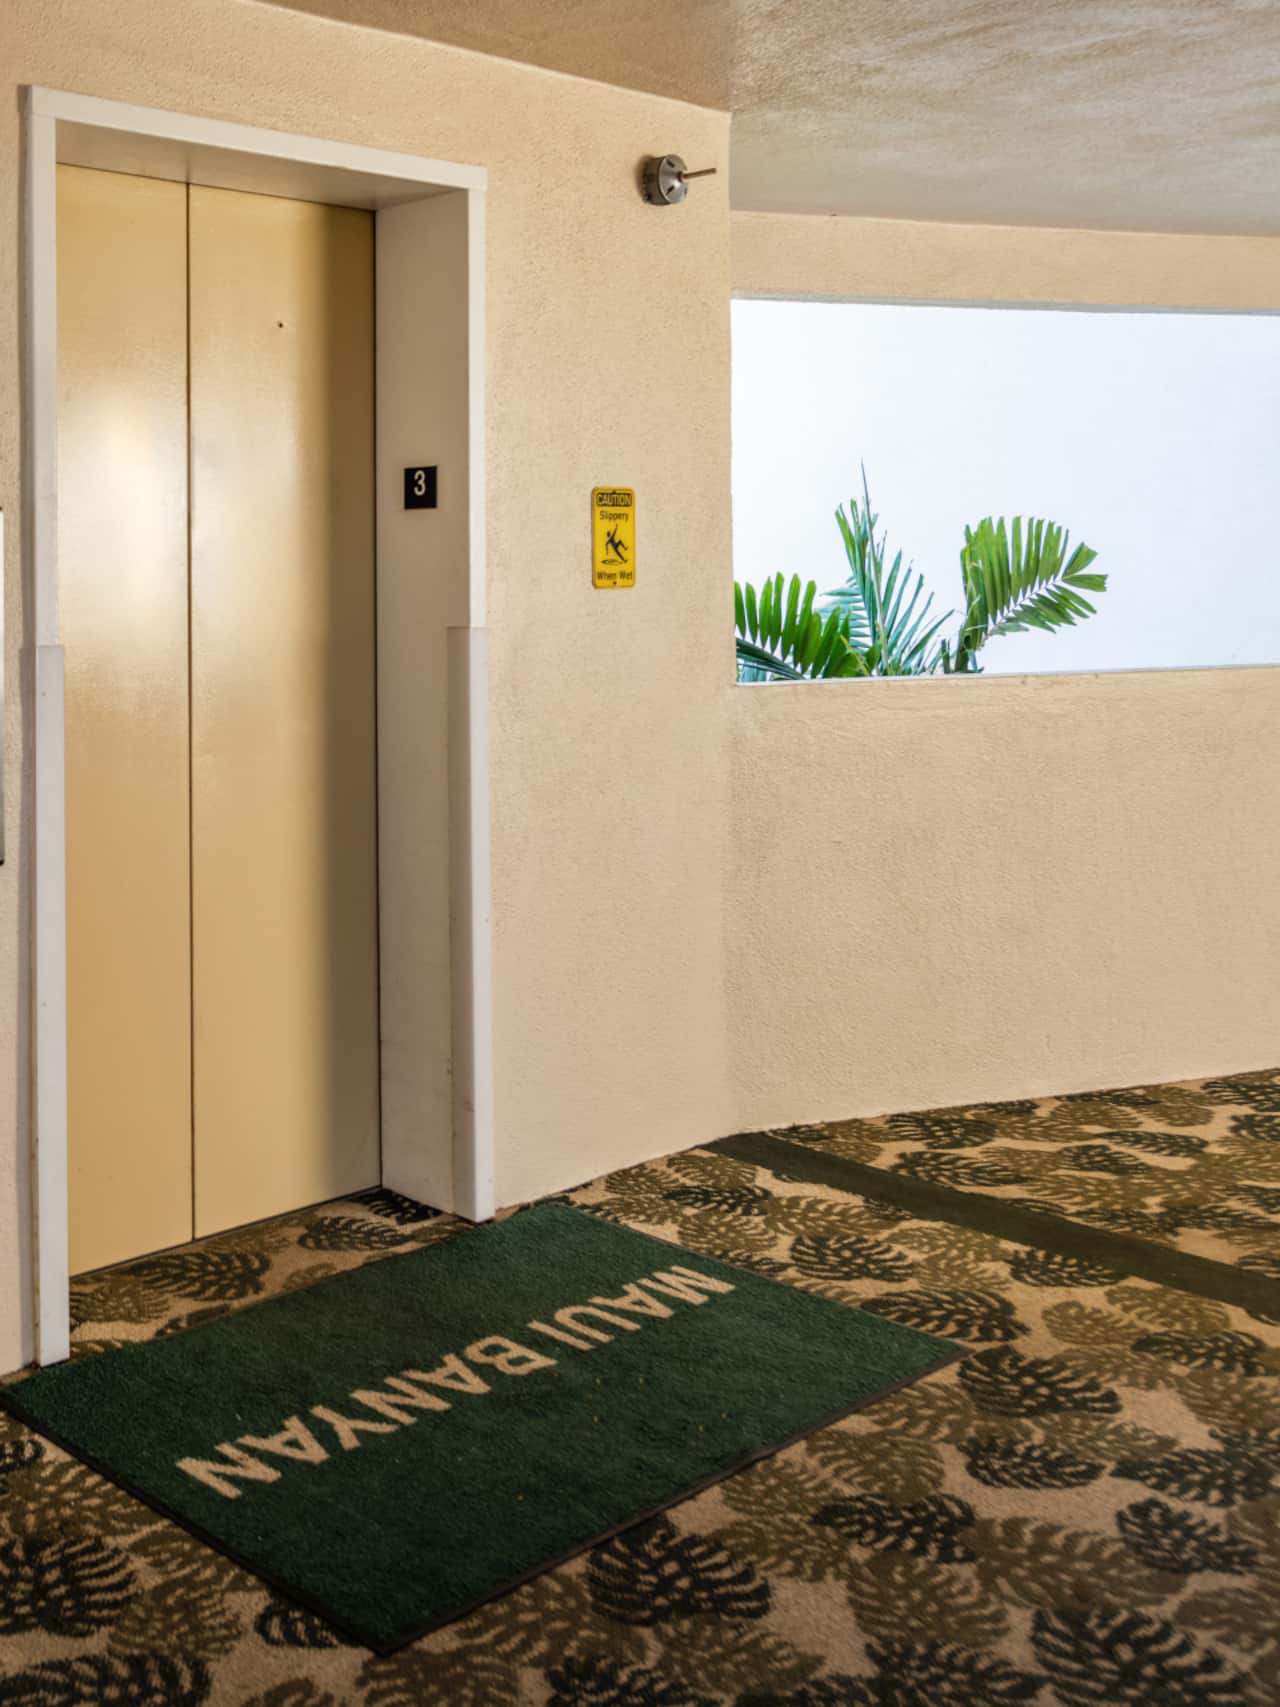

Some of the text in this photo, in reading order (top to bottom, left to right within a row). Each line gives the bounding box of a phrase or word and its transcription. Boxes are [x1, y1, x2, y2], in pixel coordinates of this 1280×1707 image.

[414, 470, 426, 496] 3
[598, 494, 632, 505] CAUTION
[600, 510, 629, 522] Slippery
[597, 571, 632, 581] When Wet
[175, 1265, 736, 1499] MAUI BANYAN
